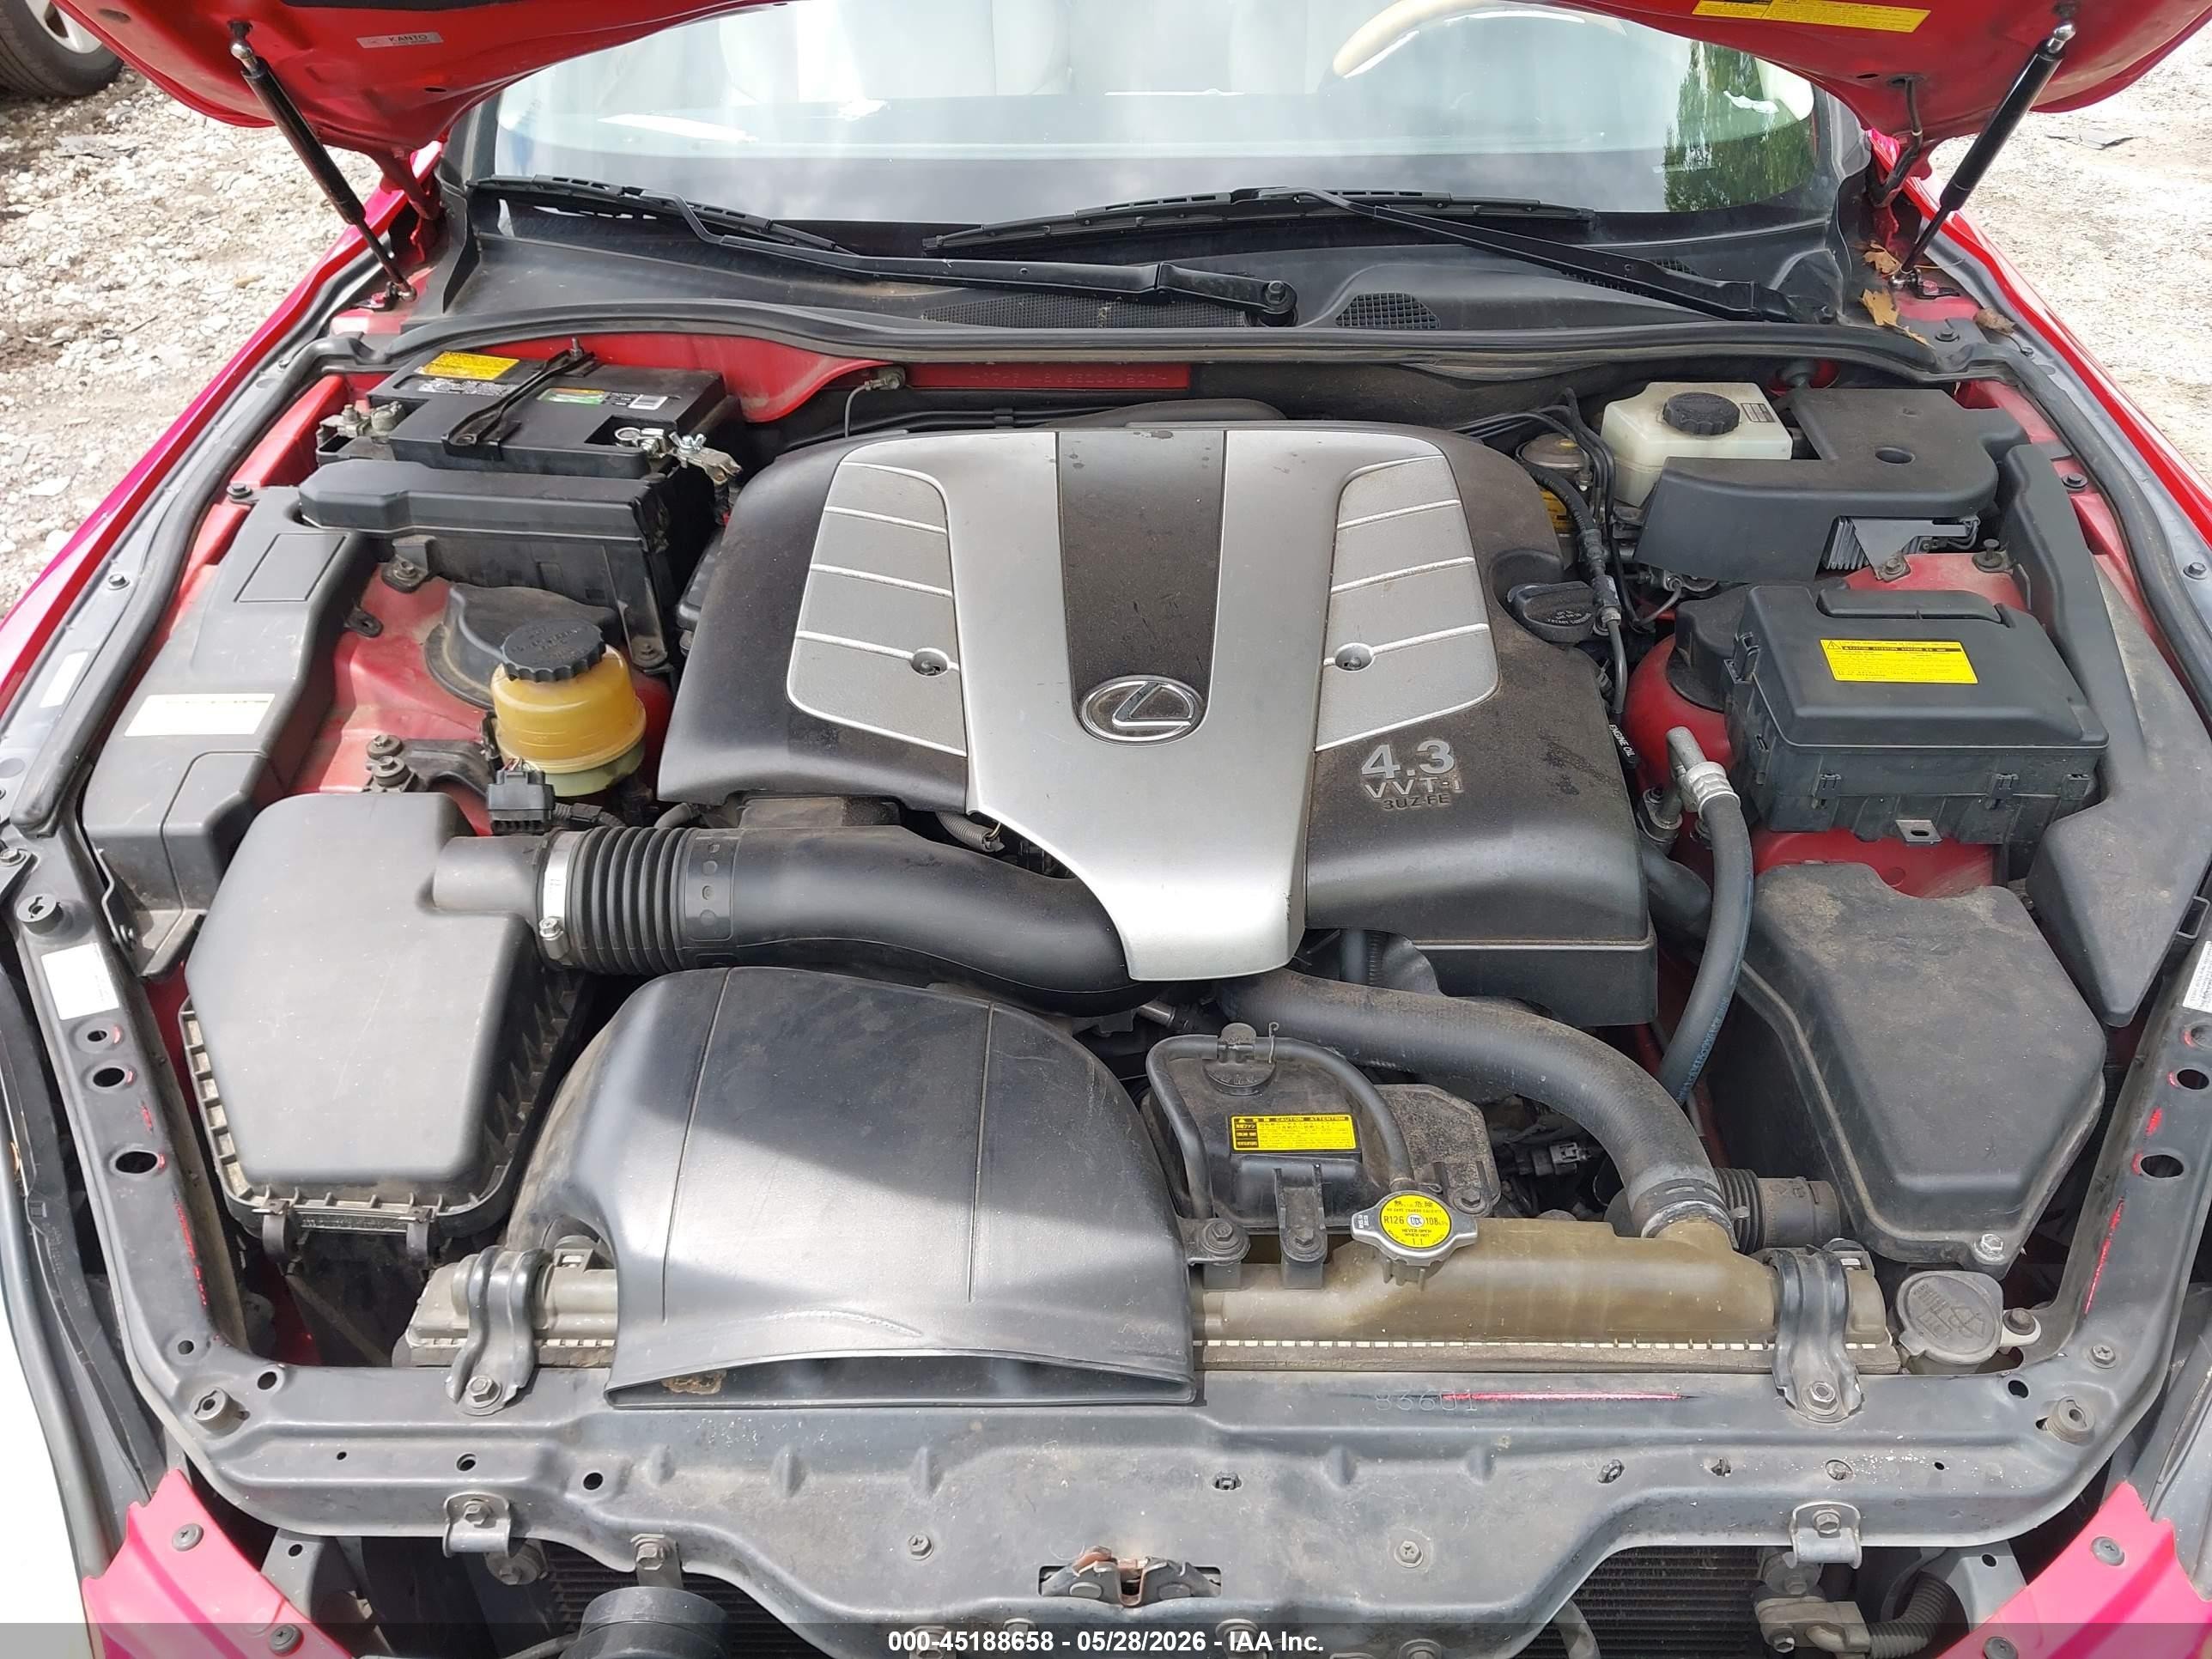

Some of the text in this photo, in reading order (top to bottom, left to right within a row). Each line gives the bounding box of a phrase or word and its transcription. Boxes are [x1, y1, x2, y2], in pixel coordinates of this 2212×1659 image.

[1361, 740, 1455, 780] 4.3
[1382, 793, 1451, 811] 3UZ-FE
[1383, 1215, 1405, 1224] R126
